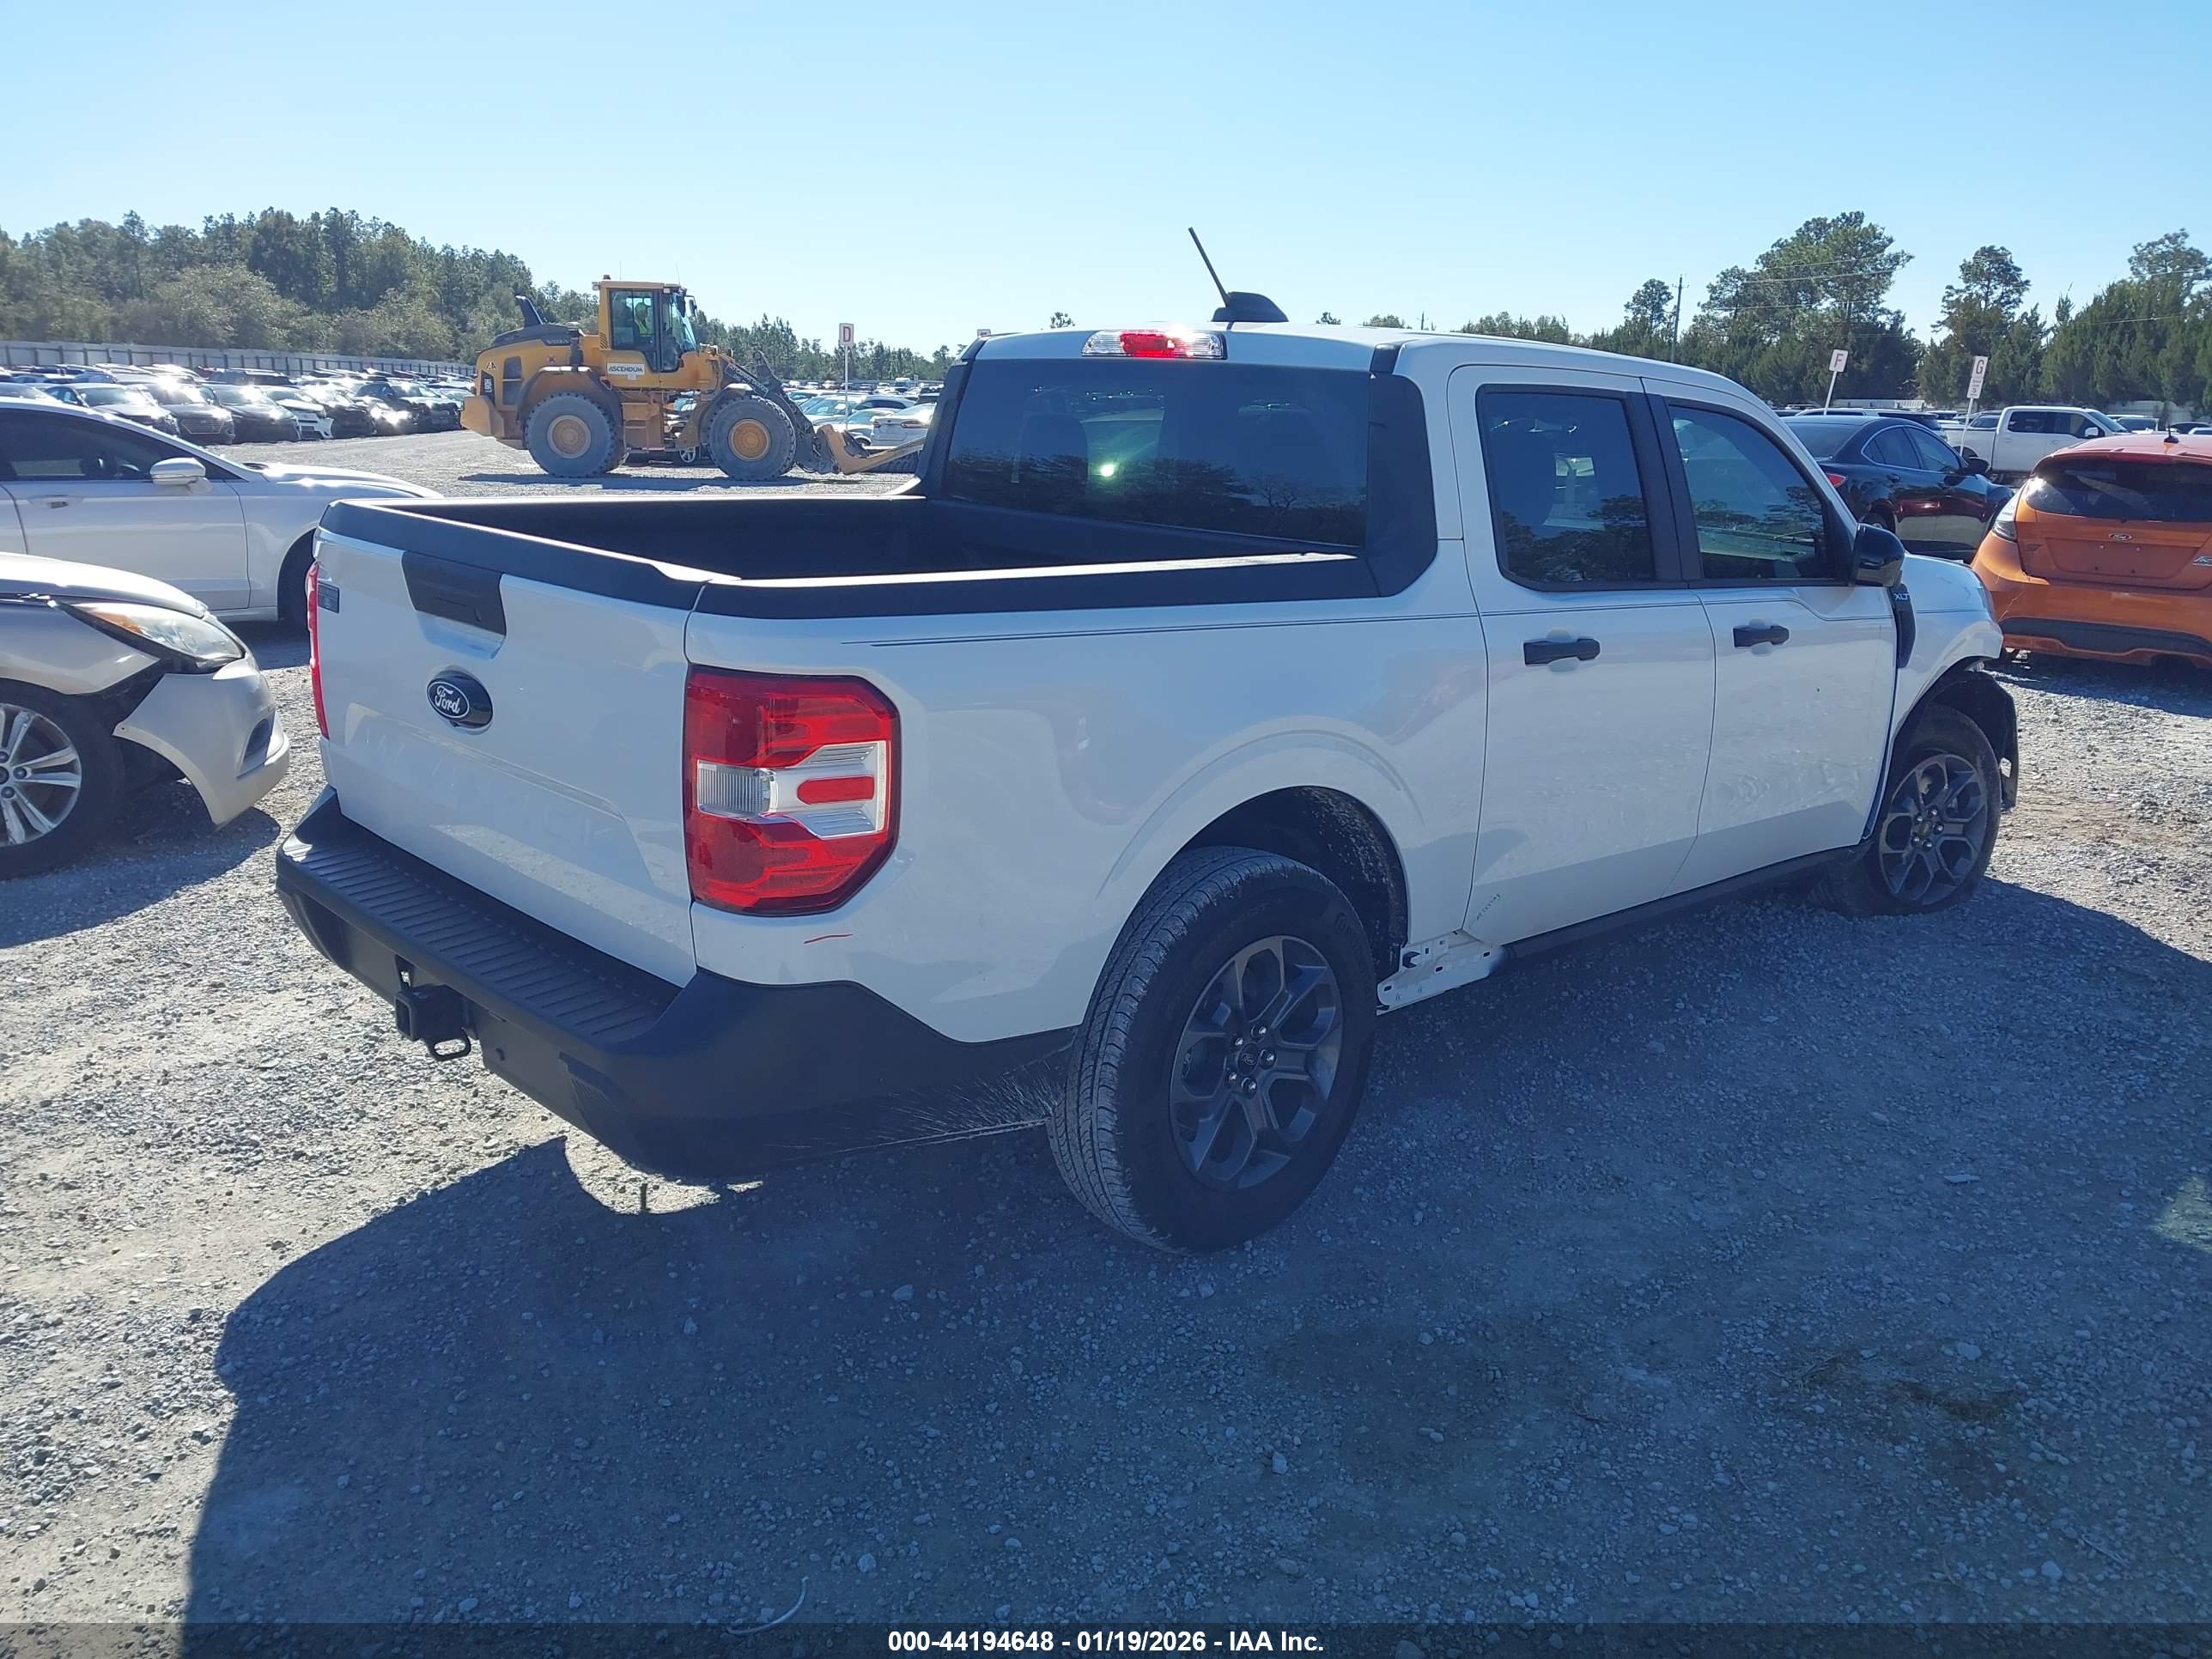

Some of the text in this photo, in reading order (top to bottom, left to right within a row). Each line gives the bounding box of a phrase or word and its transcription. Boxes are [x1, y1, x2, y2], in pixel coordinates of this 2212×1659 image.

[843, 326, 851, 342] D
[1834, 353, 1844, 368] F
[1976, 360, 1984, 374] G
[434, 685, 461, 714] Ford
